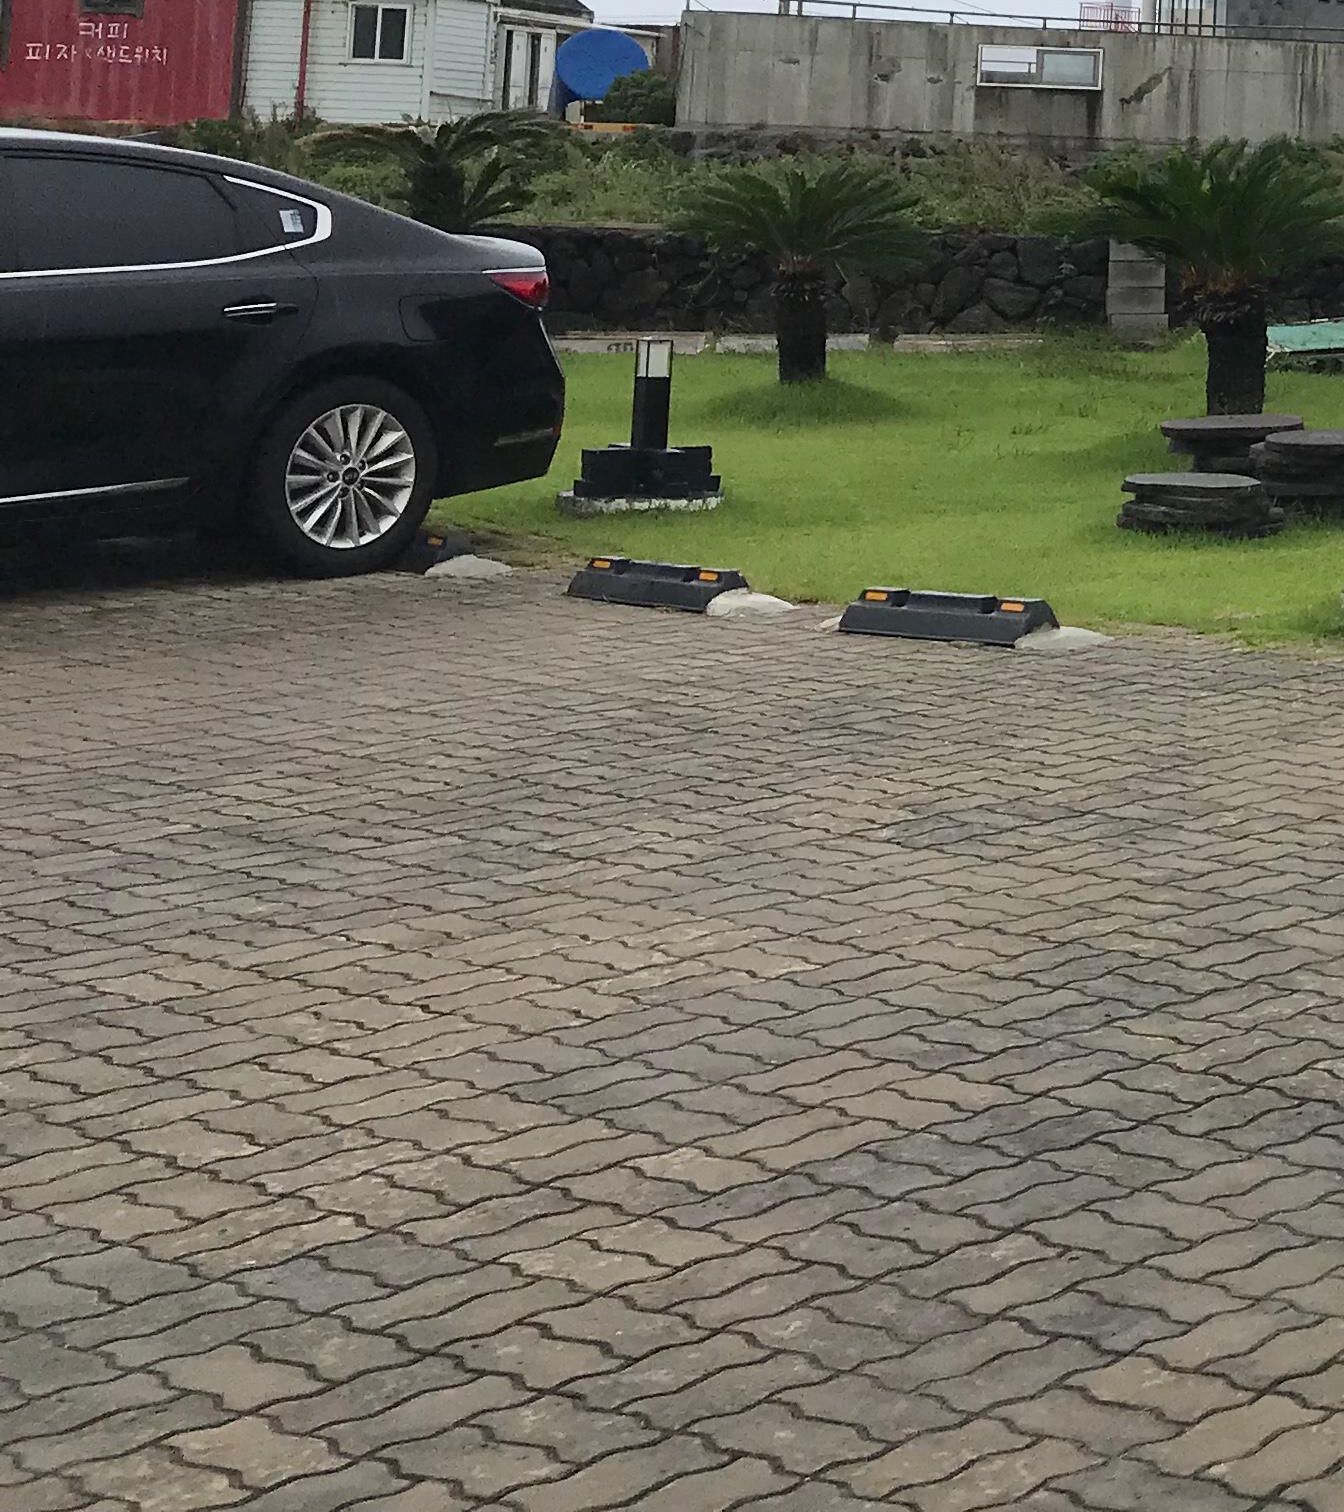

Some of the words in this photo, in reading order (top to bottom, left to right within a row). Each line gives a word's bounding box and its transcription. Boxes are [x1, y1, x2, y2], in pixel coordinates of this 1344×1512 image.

[78, 22, 129, 39] 커피
[24, 43, 78, 63] 피자
[96, 44, 168, 66] 샌드위치
